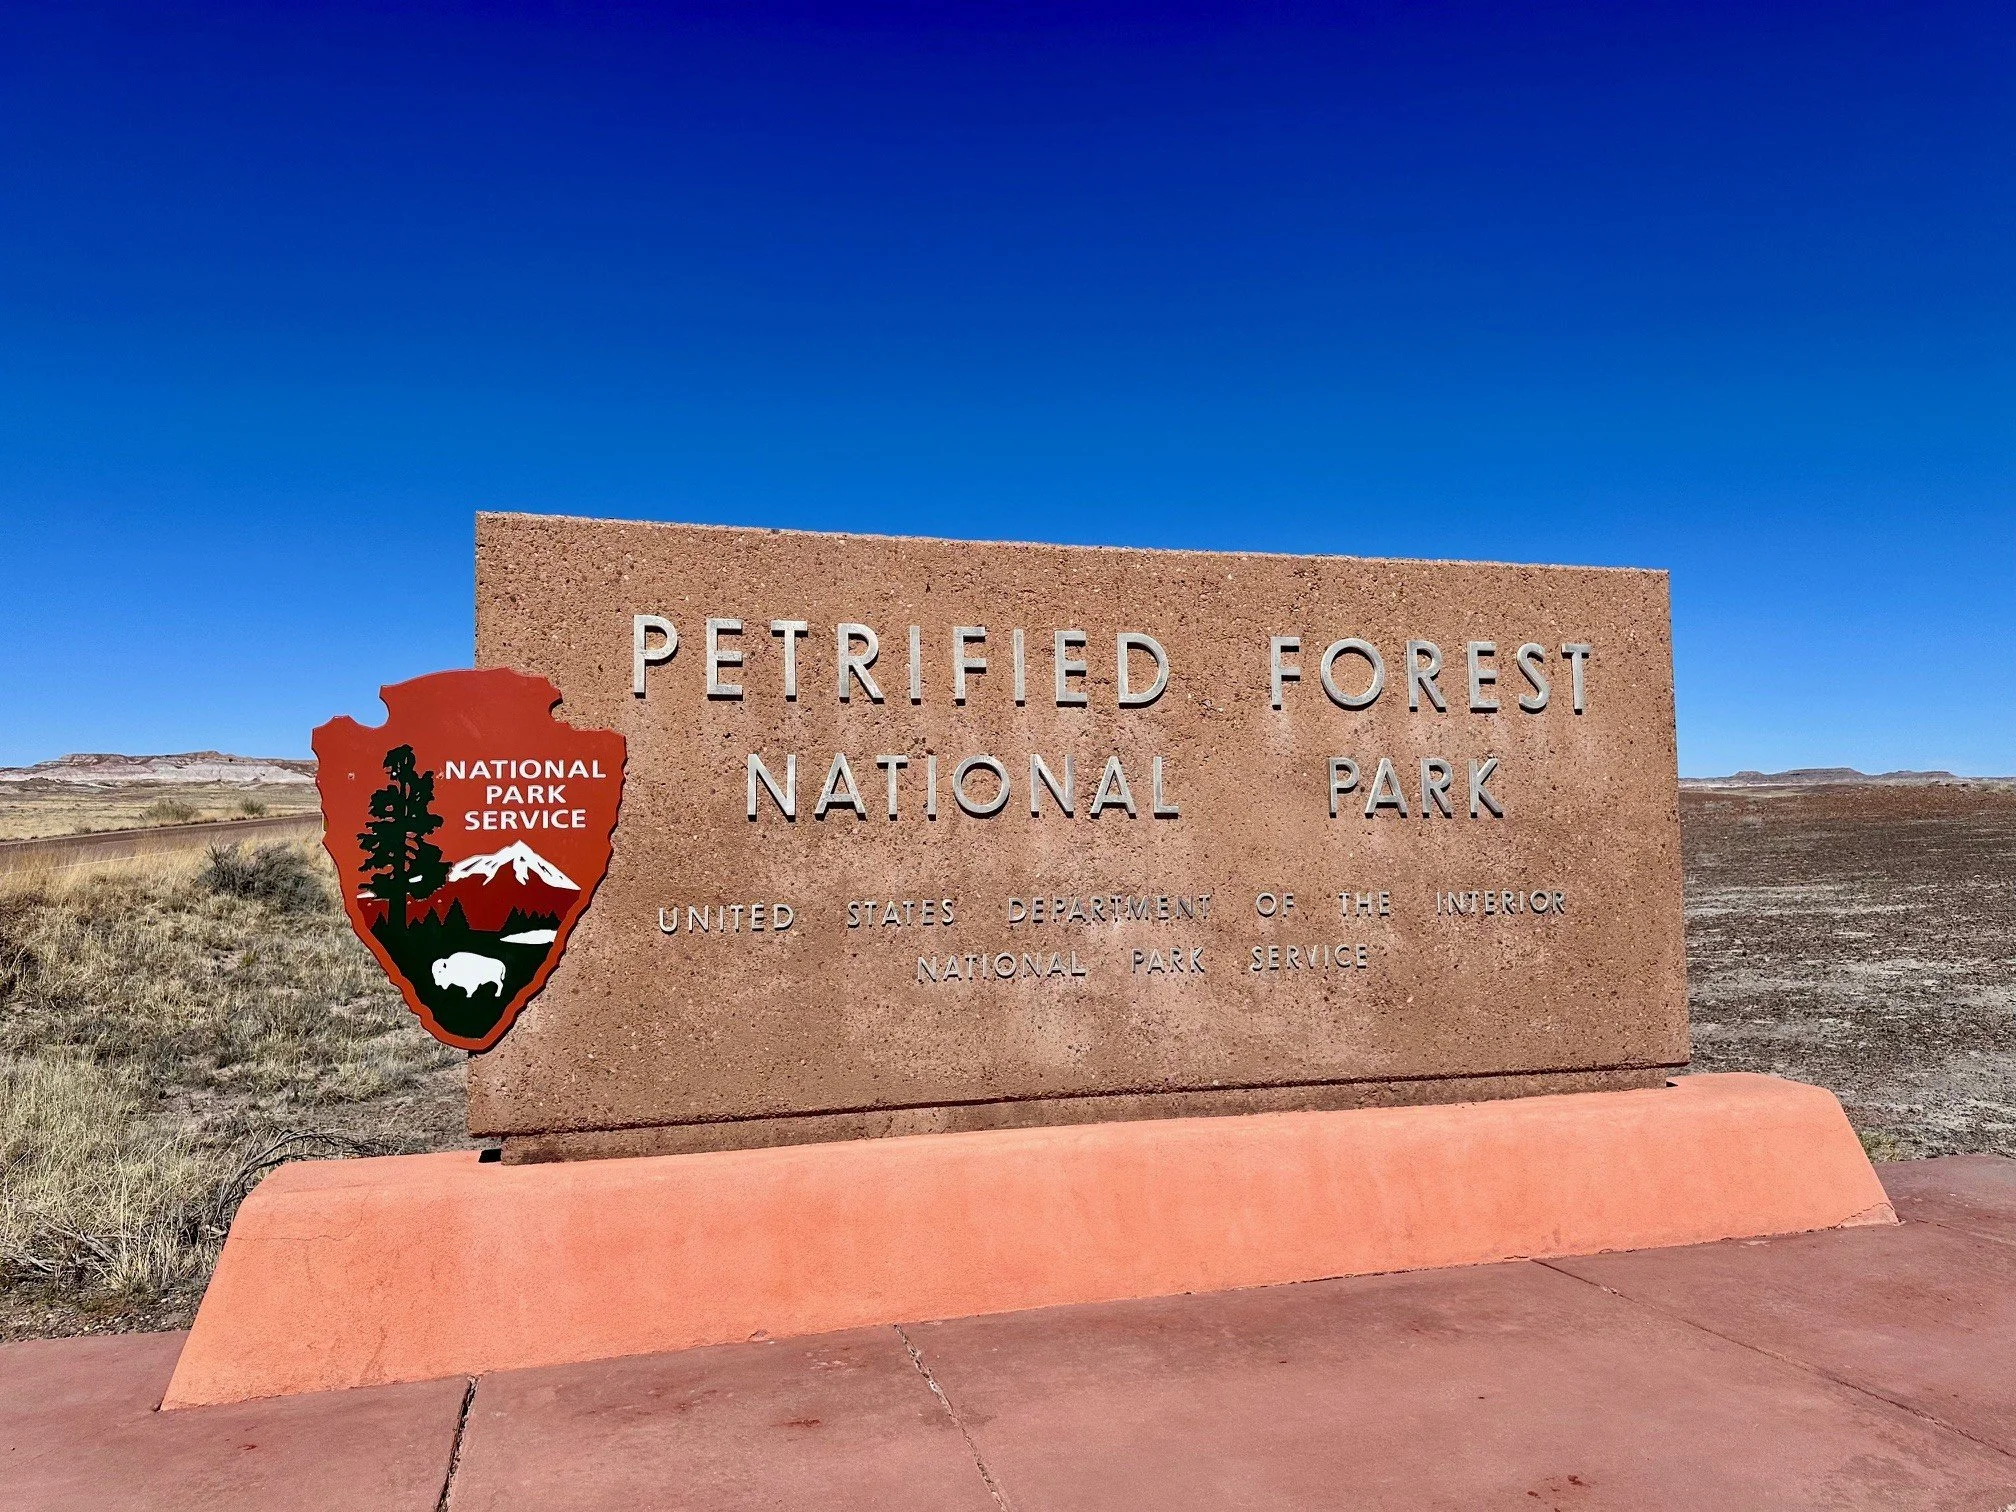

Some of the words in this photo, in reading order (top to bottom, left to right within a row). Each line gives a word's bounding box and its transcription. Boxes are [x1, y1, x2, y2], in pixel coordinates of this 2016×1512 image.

[633, 615, 1169, 707] PETRIFIED
[1270, 636, 1591, 714] FOREST
[445, 759, 606, 780] NATIONAL
[747, 753, 1179, 820] NATIONAL
[1328, 757, 1503, 818] PARK
[486, 784, 567, 805] PARK
[464, 809, 586, 831] SERVICE
[658, 902, 795, 934] UNITED
[847, 899, 955, 928] STATES
[1008, 894, 1211, 924] DEPARTMENT
[1255, 892, 1295, 918] OF
[1338, 891, 1391, 917] THE
[1437, 890, 1566, 915] INTERIOR
[917, 950, 1086, 983] NATIONAL
[1132, 946, 1205, 974] PARK
[1251, 944, 1369, 972] SERVICE
